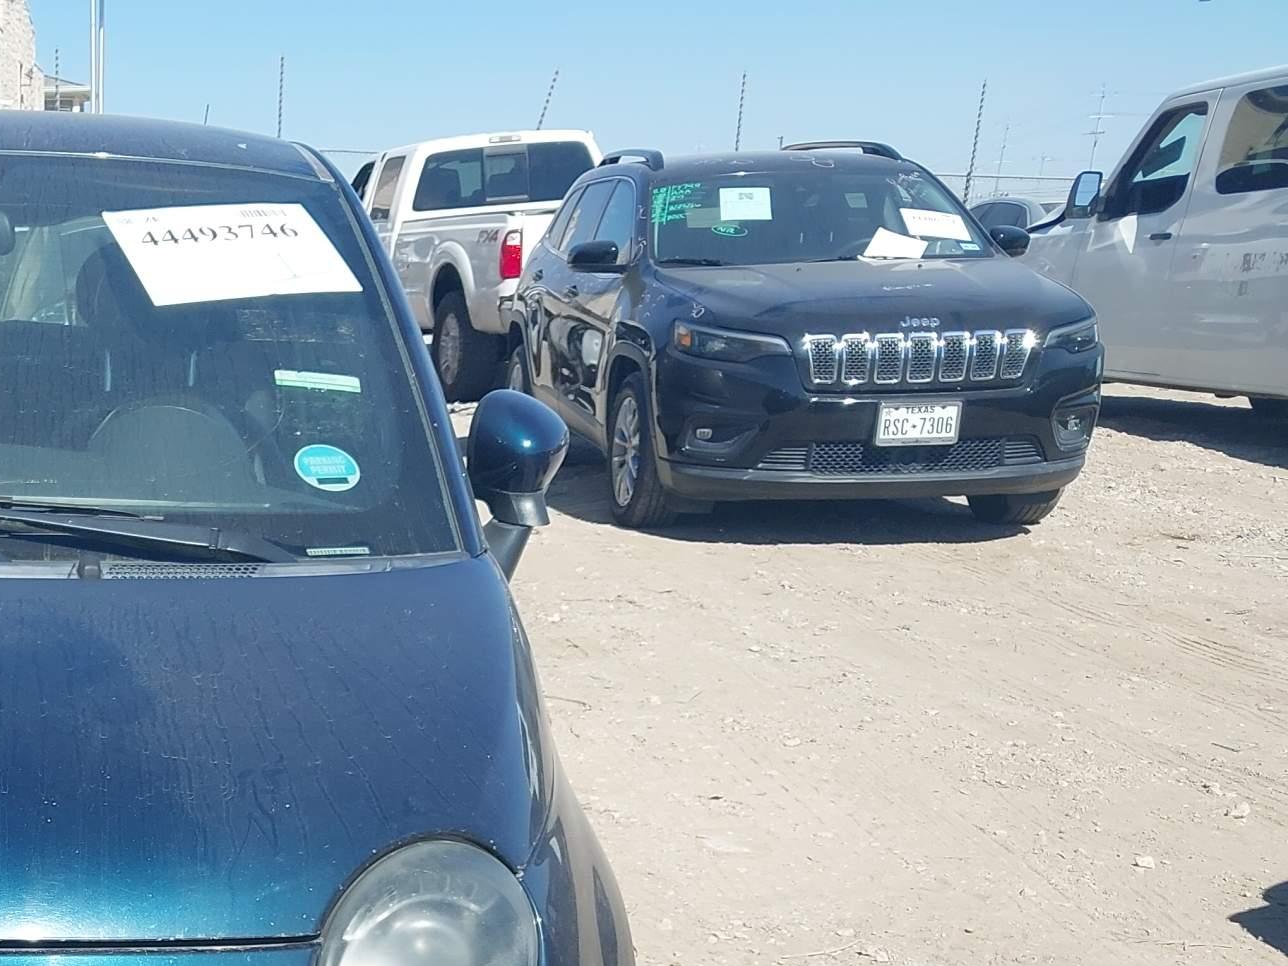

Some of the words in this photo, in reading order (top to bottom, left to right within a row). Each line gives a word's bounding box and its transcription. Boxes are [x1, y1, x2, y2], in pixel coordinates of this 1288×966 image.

[141, 223, 298, 246] 44493746
[899, 315, 941, 328] Jeep
[906, 405, 936, 414] TEXAS
